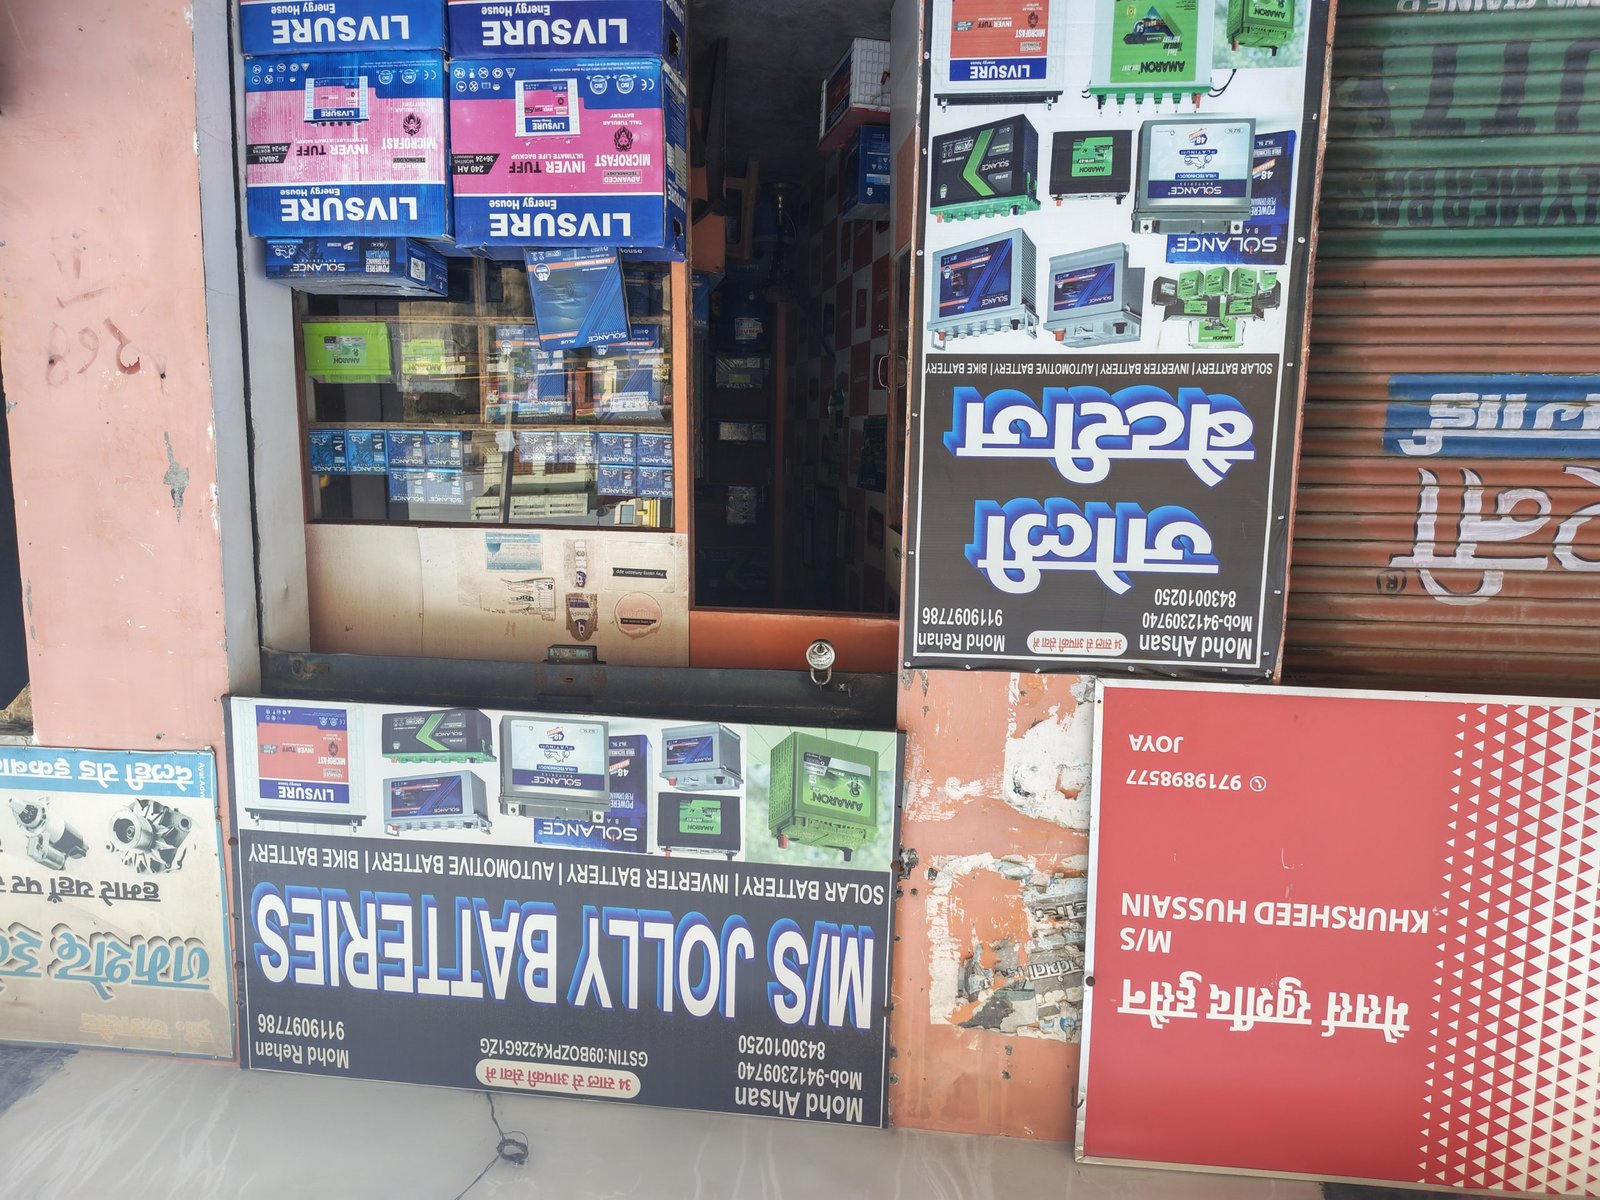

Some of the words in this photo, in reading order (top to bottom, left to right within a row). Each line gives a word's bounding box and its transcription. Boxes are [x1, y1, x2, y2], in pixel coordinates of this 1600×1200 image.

[271, 4, 300, 15] House
[303, 2, 336, 15] Energy
[481, 4, 513, 17] House
[515, 3, 551, 16] Energy
[1254, 7, 1286, 19] AMARON
[271, 15, 409, 44] LIVSURE
[481, 18, 628, 46] LIVSURE
[977, 20, 992, 29] TUFF
[993, 20, 1012, 28] INVER
[969, 64, 1030, 79] LIVSURE
[1140, 60, 1185, 74] AMARON
[532, 122, 565, 130] LIVSURE
[295, 144, 327, 157] TUFF
[330, 143, 368, 155] INVER
[381, 137, 436, 150] MICROFAST
[475, 155, 494, 163] 36+24
[511, 153, 537, 161] BACKUP
[594, 153, 651, 167] MICROFAST
[982, 159, 1009, 171] SOLANCE
[457, 165, 469, 173] AH
[470, 165, 484, 173] 240
[508, 160, 542, 174] TUFF
[545, 160, 586, 174] INVER
[279, 188, 308, 197] House
[310, 187, 340, 196] Energy
[1170, 186, 1222, 195] SOLANCE
[279, 196, 418, 222] LIVSURE
[489, 199, 520, 210] House
[522, 197, 557, 209] Energy
[489, 212, 631, 237] LIVSURE
[1176, 236, 1277, 253] SOLANCE
[292, 263, 346, 272] SOLANCE
[366, 265, 390, 273] POWERED
[981, 294, 1008, 305] SOLANCE
[587, 331, 626, 343] SOLANCE
[925, 362, 965, 374] BATTERY
[967, 362, 987, 374] BIKE
[994, 362, 1034, 374] BATTERY
[1036, 362, 1094, 375] AUTOMOTIVE
[1101, 362, 1141, 374] BATTERY
[1143, 362, 1189, 375] INVERTER
[1197, 362, 1238, 375] BATTERY
[1241, 362, 1273, 375] SOLAR
[944, 385, 1254, 487] बैटरीज
[965, 498, 1219, 595] जोली
[1154, 588, 1236, 608] 8430010250
[923, 607, 1003, 626] 9119097786
[1142, 612, 1252, 632] Mob-9412309740
[918, 632, 963, 650] Rehan
[967, 633, 1005, 651] Mohd
[1139, 633, 1196, 655] Ahsan
[1201, 636, 1252, 659] Mohd
[1129, 734, 1183, 753] JOYA
[78, 759, 117, 787] रोड
[533, 776, 582, 787] SOLANCE
[1126, 769, 1242, 790] 9719898577
[278, 785, 334, 801] LIVSURE
[812, 791, 864, 812] AMARON
[543, 822, 638, 842] SOLANCE
[248, 842, 317, 867] BATTERY
[322, 848, 359, 870] BIKE
[372, 851, 443, 875] BATTERY
[448, 855, 554, 881] AUTOMOTIVE
[567, 863, 641, 888] BATTERY
[12, 876, 44, 895] पर
[646, 868, 729, 894] INVERTER
[742, 875, 820, 901] BATTERY
[48, 877, 93, 903] यहाँ
[100, 880, 161, 906] हमारे
[824, 881, 884, 906] SOLAR
[1121, 892, 1247, 924] HUSSAIN
[1254, 901, 1429, 933] KHURSHEED
[252, 883, 557, 1004] BATTERIES
[1120, 927, 1172, 954] M/S
[49, 924, 210, 1000] जमशेद
[568, 906, 754, 1018] JOLLY
[768, 918, 874, 1030] M/S
[1117, 971, 1202, 1029] हुसैन
[1321, 992, 1410, 1043] मैसर्स
[257, 1013, 345, 1041] 9119097786
[255, 1041, 303, 1064] Rehan
[738, 1035, 825, 1060] 8430010250
[307, 1046, 349, 1069] Mohd
[500, 1068, 524, 1085] सेवा
[528, 1070, 569, 1087] आपकी
[572, 1074, 584, 1091] से
[587, 1075, 615, 1090] साल
[737, 1061, 862, 1090] Mob-9412309740
[735, 1087, 800, 1116] Ahsan
[805, 1093, 863, 1122] Mohd
